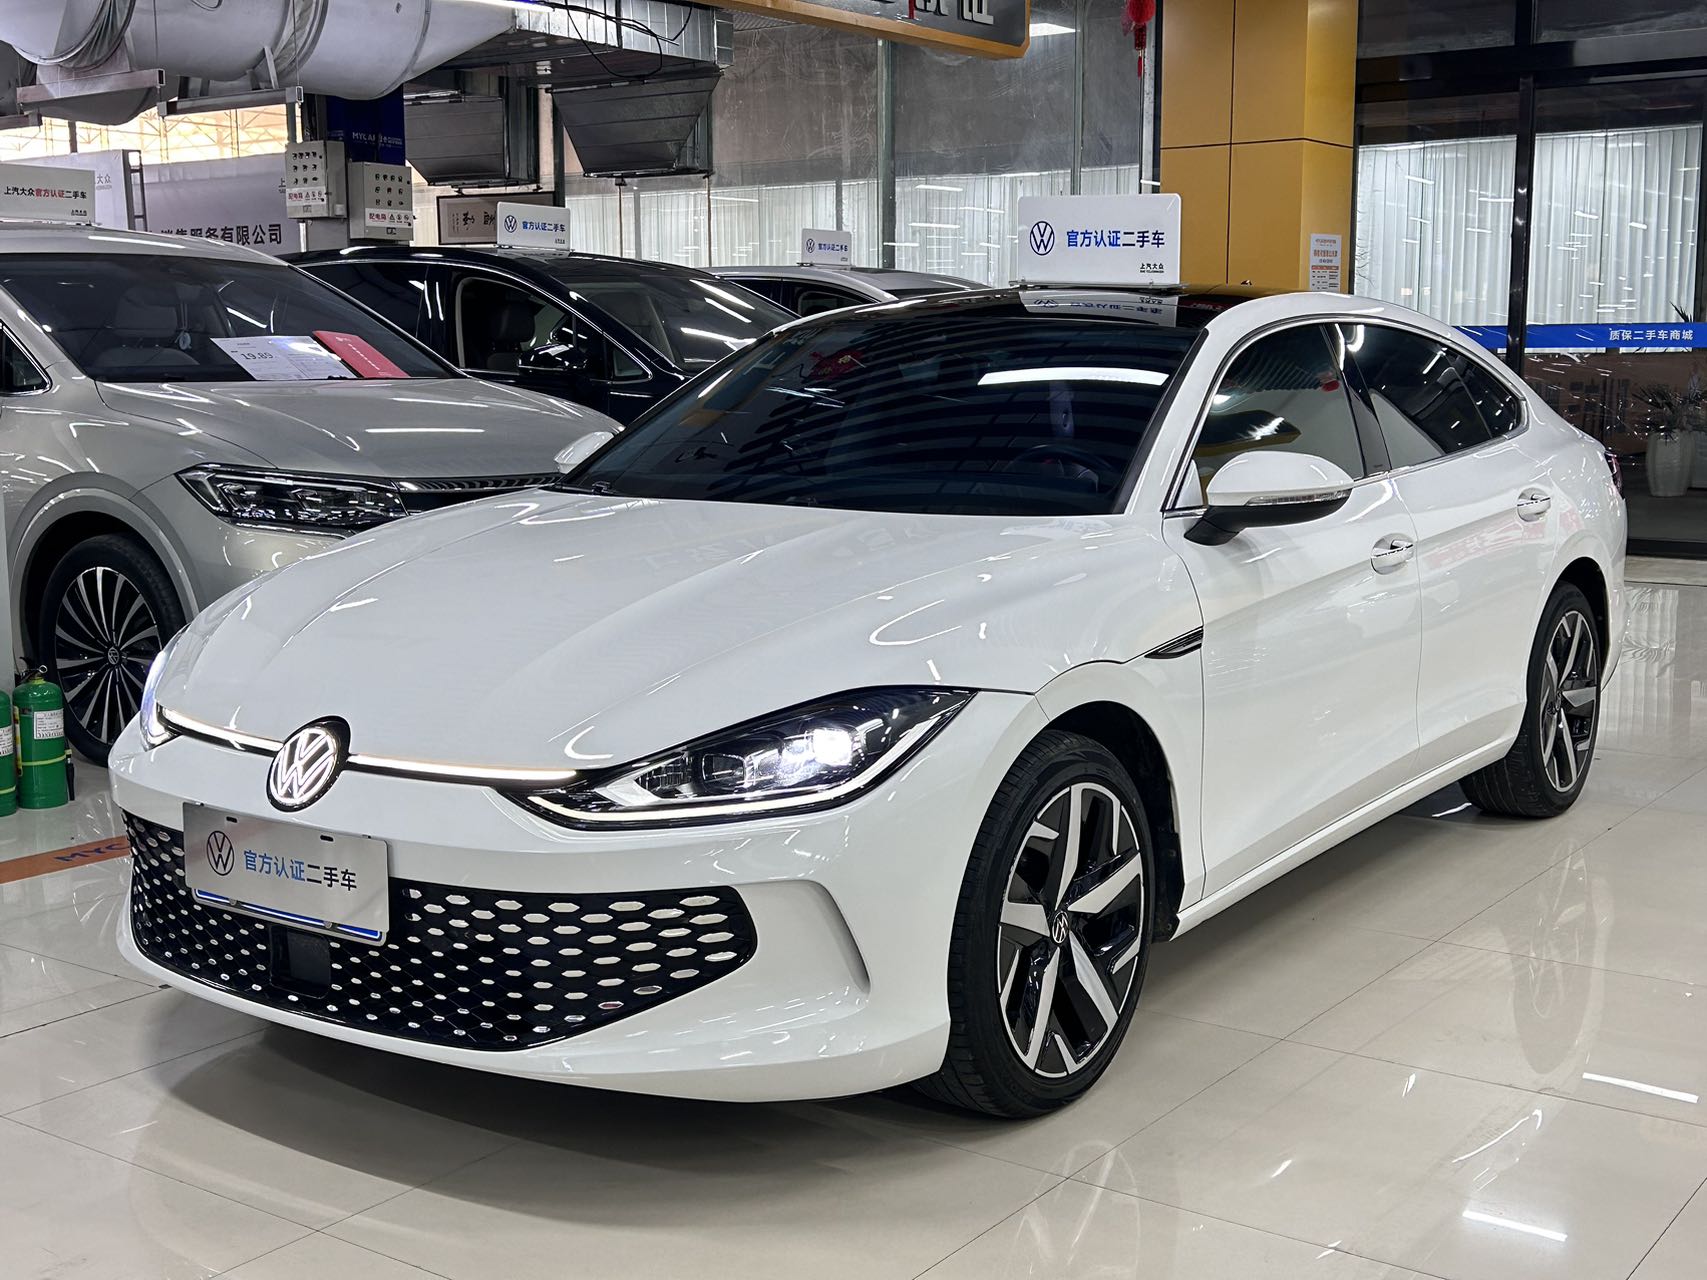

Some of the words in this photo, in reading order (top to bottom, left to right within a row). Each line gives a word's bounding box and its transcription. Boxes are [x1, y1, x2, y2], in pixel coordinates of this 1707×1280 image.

[3, 185, 87, 199] 上汽大众官方认证二手车
[521, 220, 566, 233] 官方认证二手车
[1066, 229, 1165, 249] 官方认证二手车
[1609, 329, 1694, 341] 质保二手车商城
[243, 850, 358, 891] 官方认证二手车
